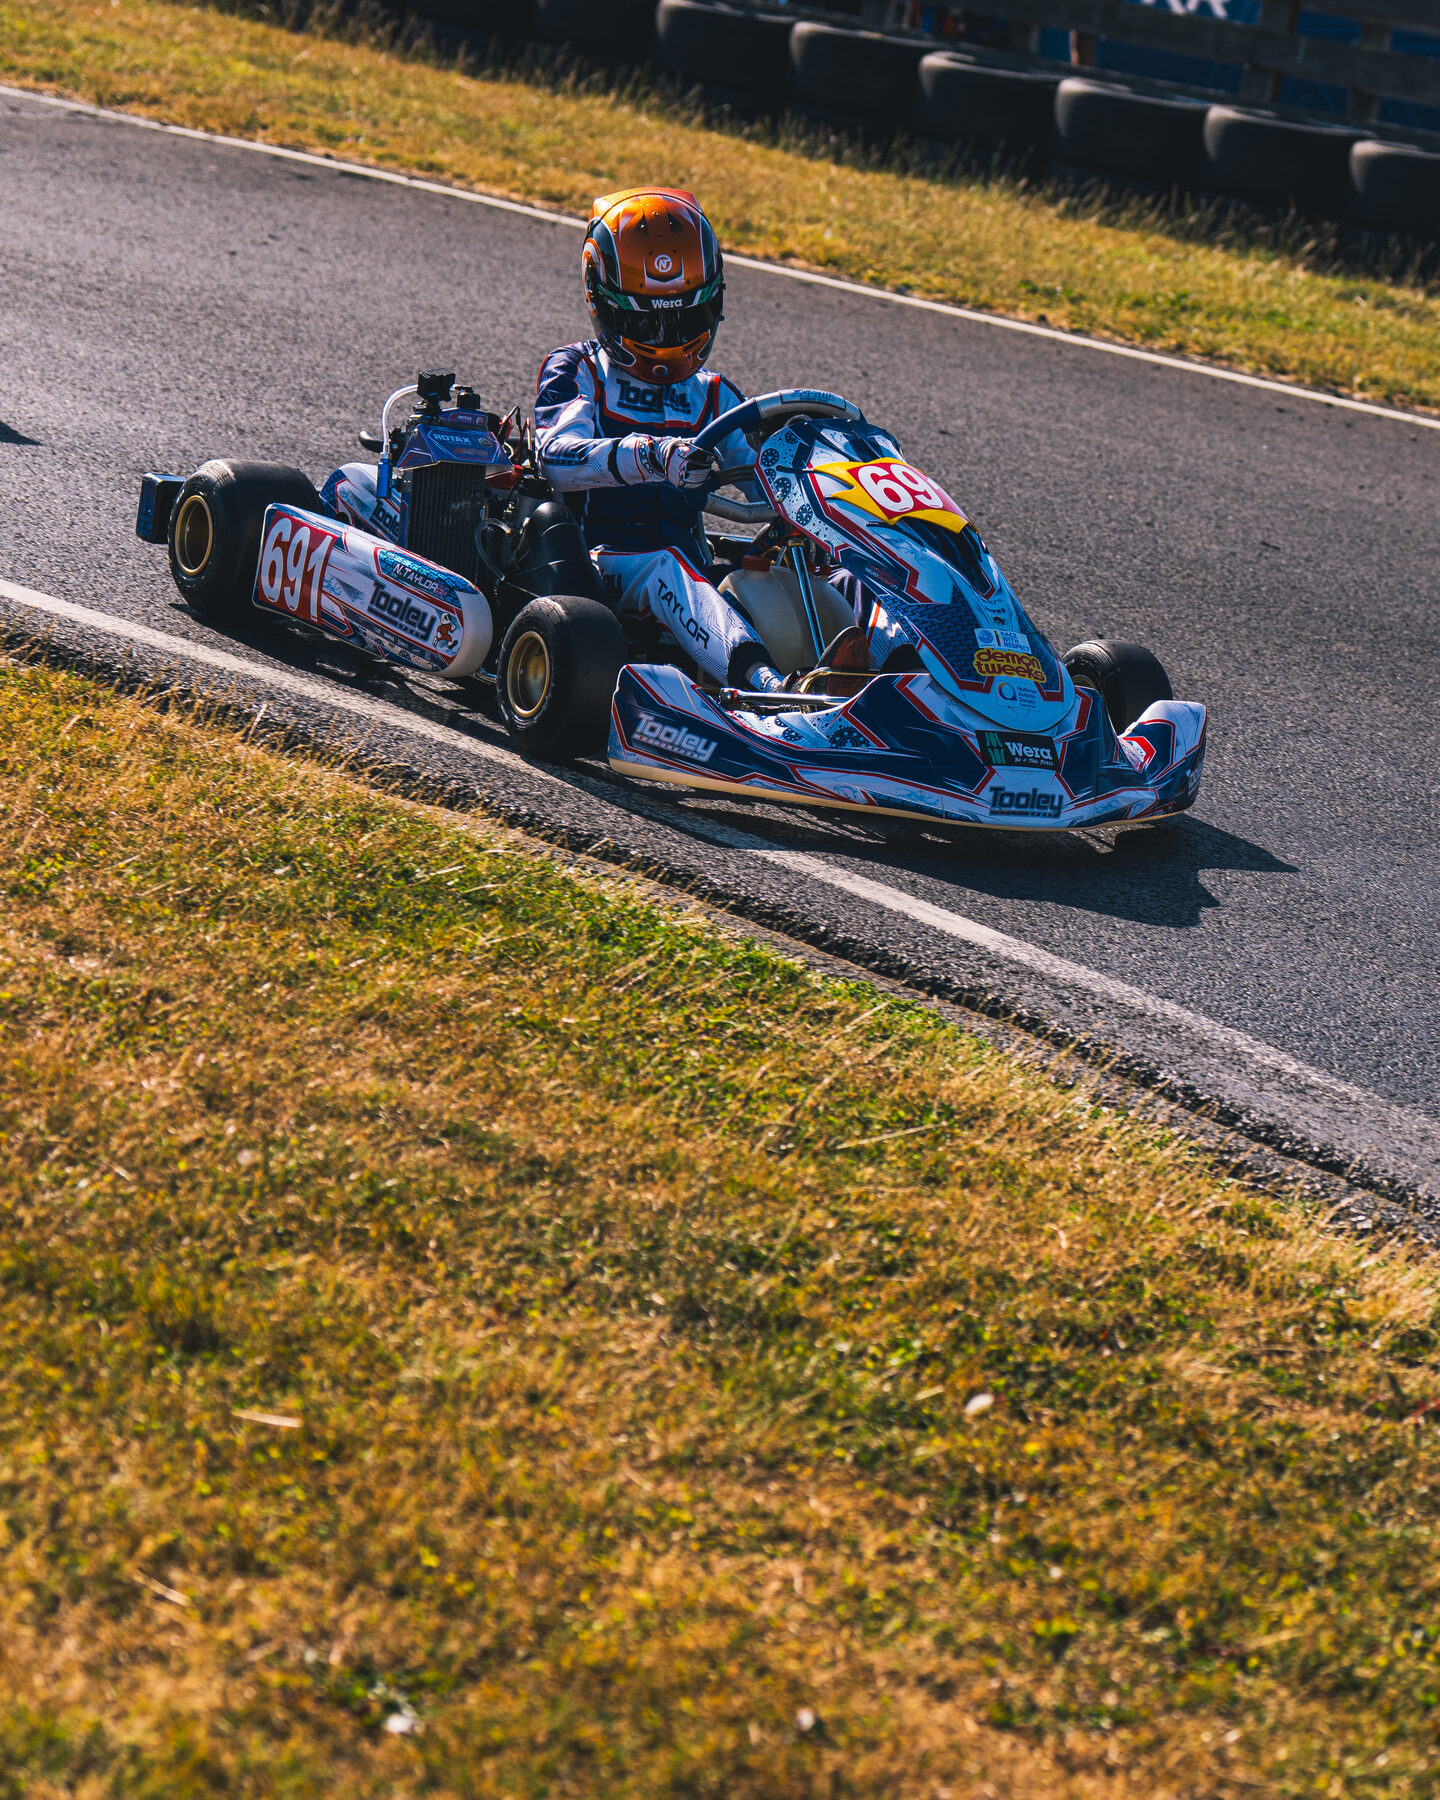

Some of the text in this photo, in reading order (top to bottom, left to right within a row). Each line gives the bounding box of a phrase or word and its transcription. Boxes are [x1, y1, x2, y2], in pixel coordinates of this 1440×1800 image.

[651, 299, 683, 310] Wera
[433, 434, 472, 443] ROTAX
[261, 518, 333, 622] 691
[392, 563, 438, 594] N.TAYLOR
[369, 581, 438, 640] Tooley
[657, 578, 710, 649] TAYLOR
[976, 649, 1040, 669] demon
[1004, 643, 1030, 652] RESPECT
[975, 660, 1046, 682] tweeks
[636, 713, 718, 762] Tooley
[1004, 742, 1053, 760] Wera
[989, 786, 1064, 818] Tooley
